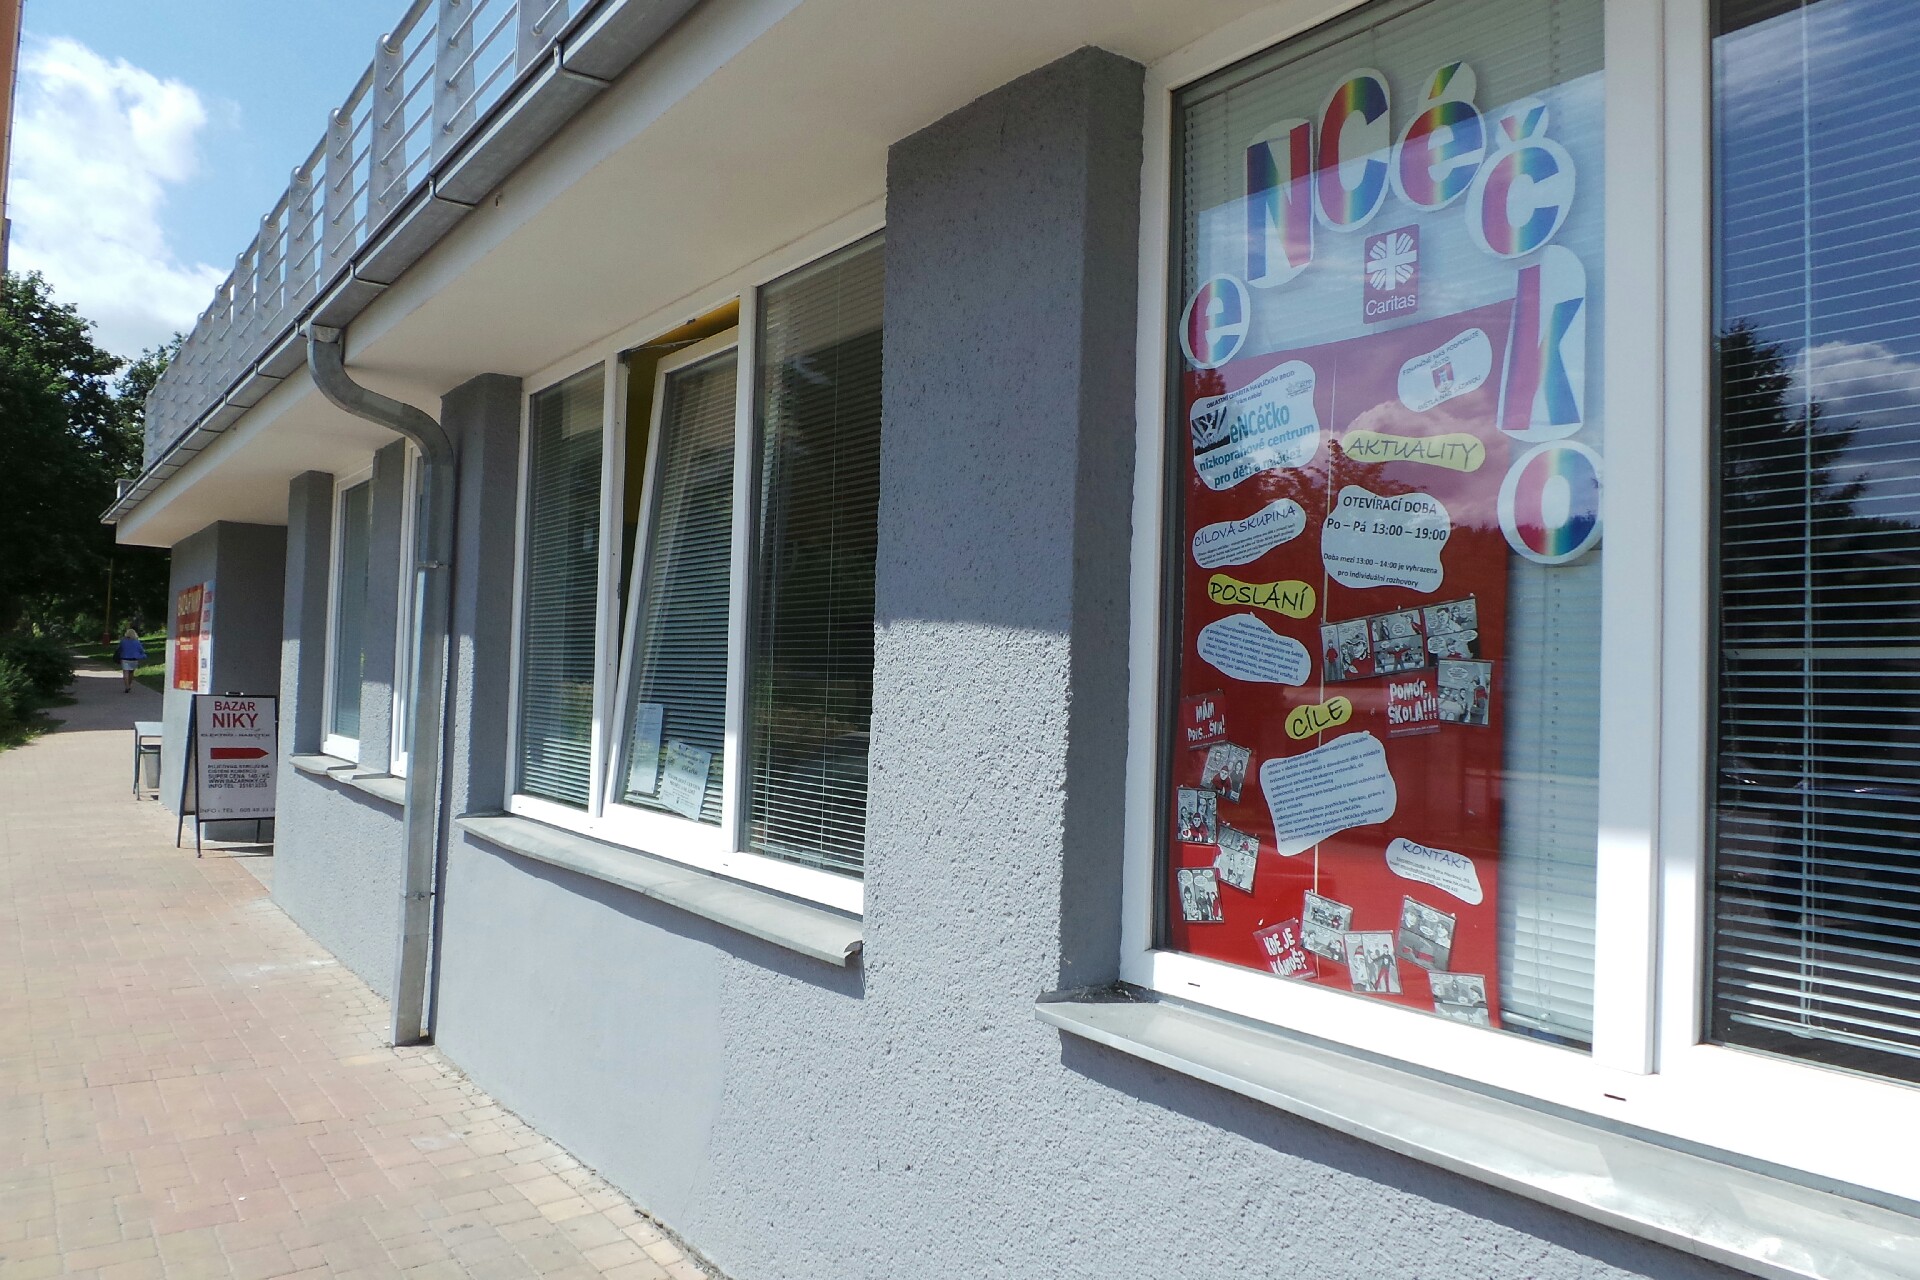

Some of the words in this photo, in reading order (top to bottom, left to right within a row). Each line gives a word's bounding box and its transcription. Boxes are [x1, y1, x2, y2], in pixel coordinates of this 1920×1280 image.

[1365, 294, 1416, 316] Caritas
[1230, 401, 1290, 444] eNCéčko
[1200, 438, 1265, 472] nízkoprahové
[1268, 424, 1314, 448] centrum
[1347, 438, 1478, 470] AKTUALITY
[1214, 474, 1231, 488] pro
[1343, 495, 1403, 512] OTEVÍRACÍ
[1404, 501, 1437, 515] DOBA
[1194, 521, 1236, 547] CÍLOVÁ
[1238, 506, 1295, 533] SKUPINA
[1326, 518, 1341, 530] Po
[1353, 521, 1366, 532] Pá
[1372, 523, 1403, 536] 13:00
[1414, 527, 1447, 541] 19:00
[1323, 553, 1339, 561] Doba
[1356, 558, 1373, 566] 13:00
[1379, 560, 1397, 569] 14:00
[1397, 563, 1404, 571] je
[1405, 563, 1438, 574] vyhrazena
[1386, 577, 1418, 587] rozhovory
[1210, 582, 1308, 611] POSLÁNÍ
[214, 701, 256, 711] BAZAR
[1292, 699, 1343, 737] CÍLE
[1388, 693, 1438, 725] ŠKOLA!!!
[212, 713, 259, 728] NIKY
[1402, 842, 1471, 870] KONTAKT
[1263, 933, 1283, 955] KDE
[1283, 928, 1296, 949] JE
